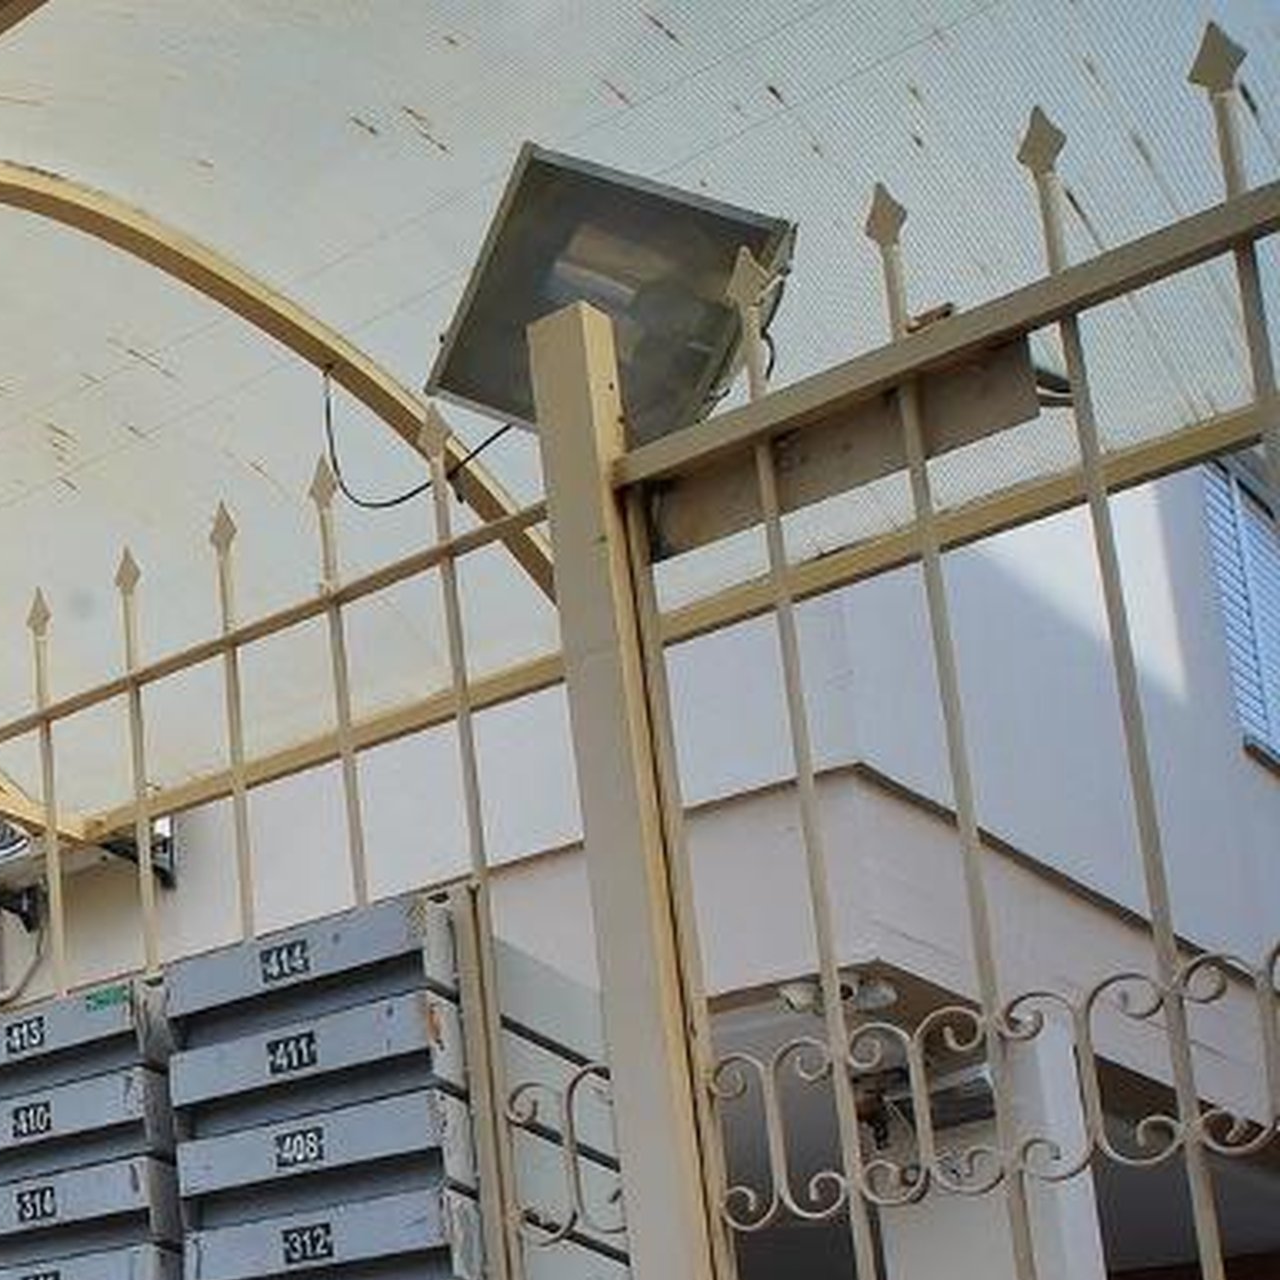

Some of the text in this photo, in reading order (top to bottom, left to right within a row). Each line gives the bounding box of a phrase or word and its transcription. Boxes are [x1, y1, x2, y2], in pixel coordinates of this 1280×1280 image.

[265, 943, 304, 980] 414
[272, 1033, 311, 1070] 411
[16, 1104, 48, 1135] 410
[280, 1129, 318, 1165] 408
[287, 1225, 328, 1262] 312
